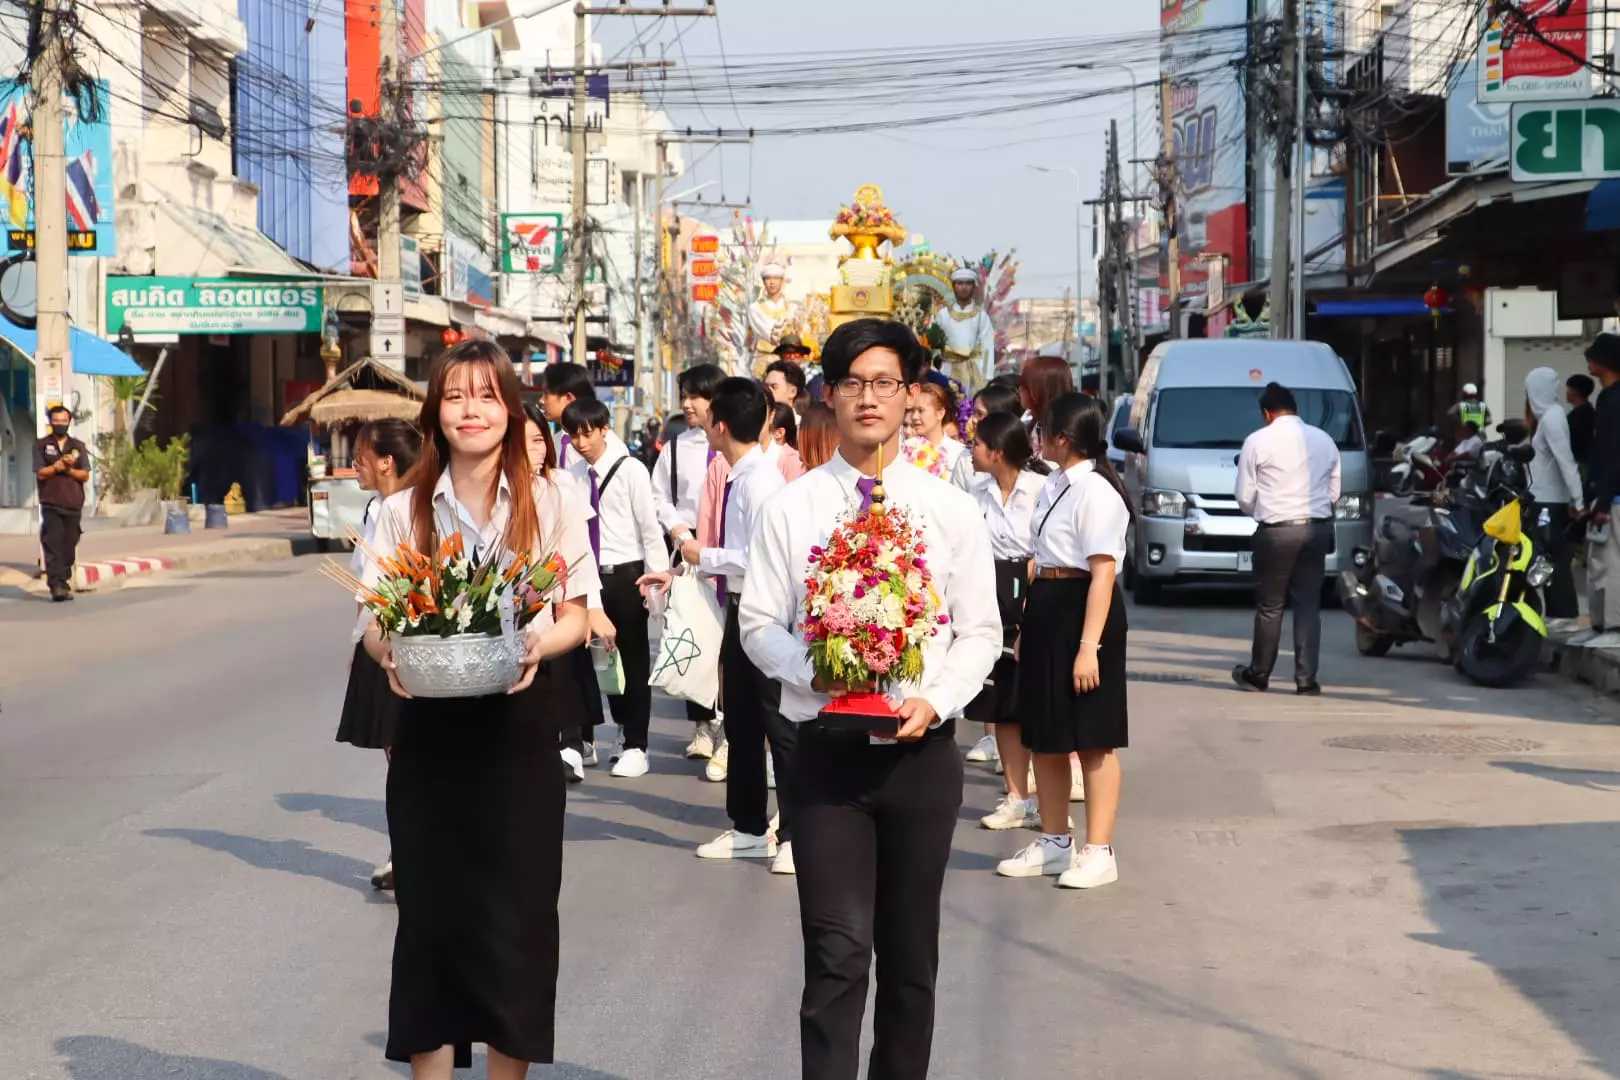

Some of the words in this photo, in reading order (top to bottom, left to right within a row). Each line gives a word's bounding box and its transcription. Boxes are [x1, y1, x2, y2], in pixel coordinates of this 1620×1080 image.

[1470, 125, 1502, 137] THAI
[1516, 107, 1620, 174] ยา
[111, 285, 184, 306] สมคิด
